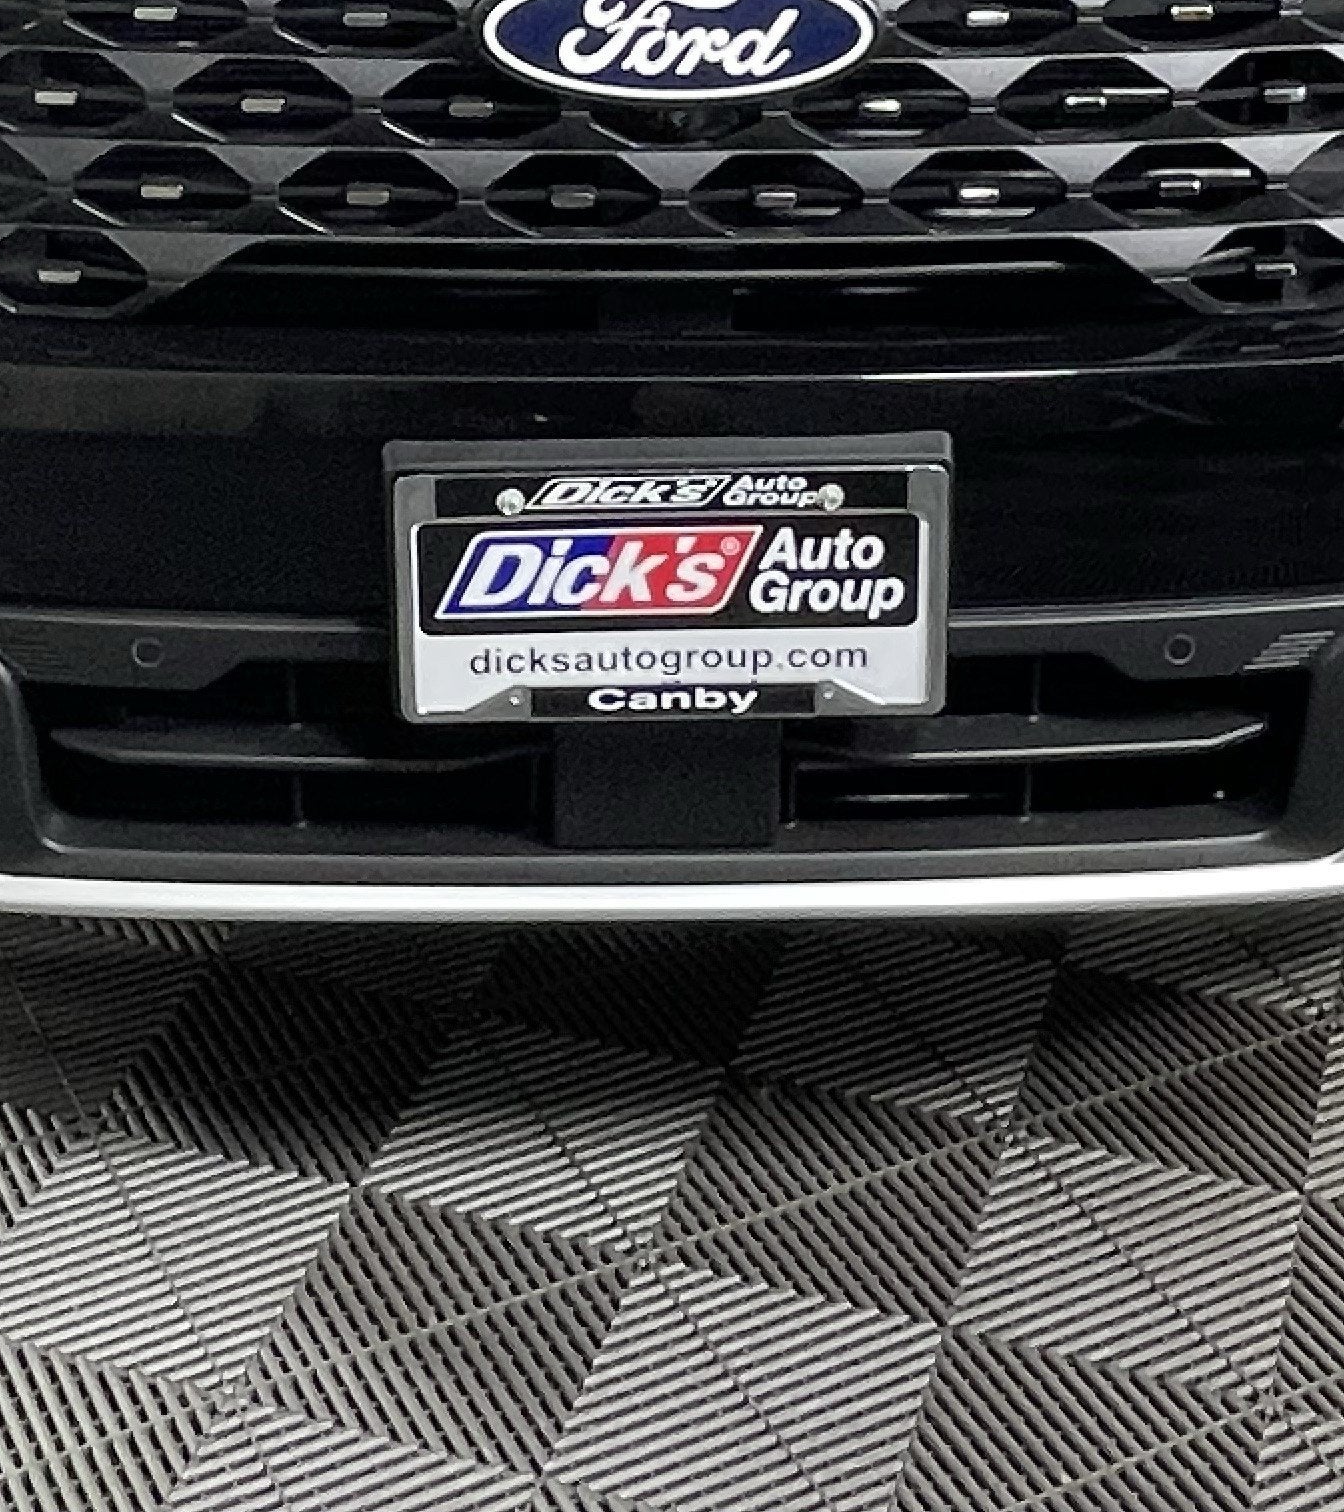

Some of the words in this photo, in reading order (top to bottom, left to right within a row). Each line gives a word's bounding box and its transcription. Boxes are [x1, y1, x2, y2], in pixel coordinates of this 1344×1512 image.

[734, 474, 808, 490] Auto
[722, 489, 819, 508] Group
[757, 526, 886, 571] Auto
[458, 537, 726, 607] Dick's
[749, 569, 906, 619] Group
[469, 645, 869, 676] dicksautogroup.com
[586, 687, 760, 715] Canby
